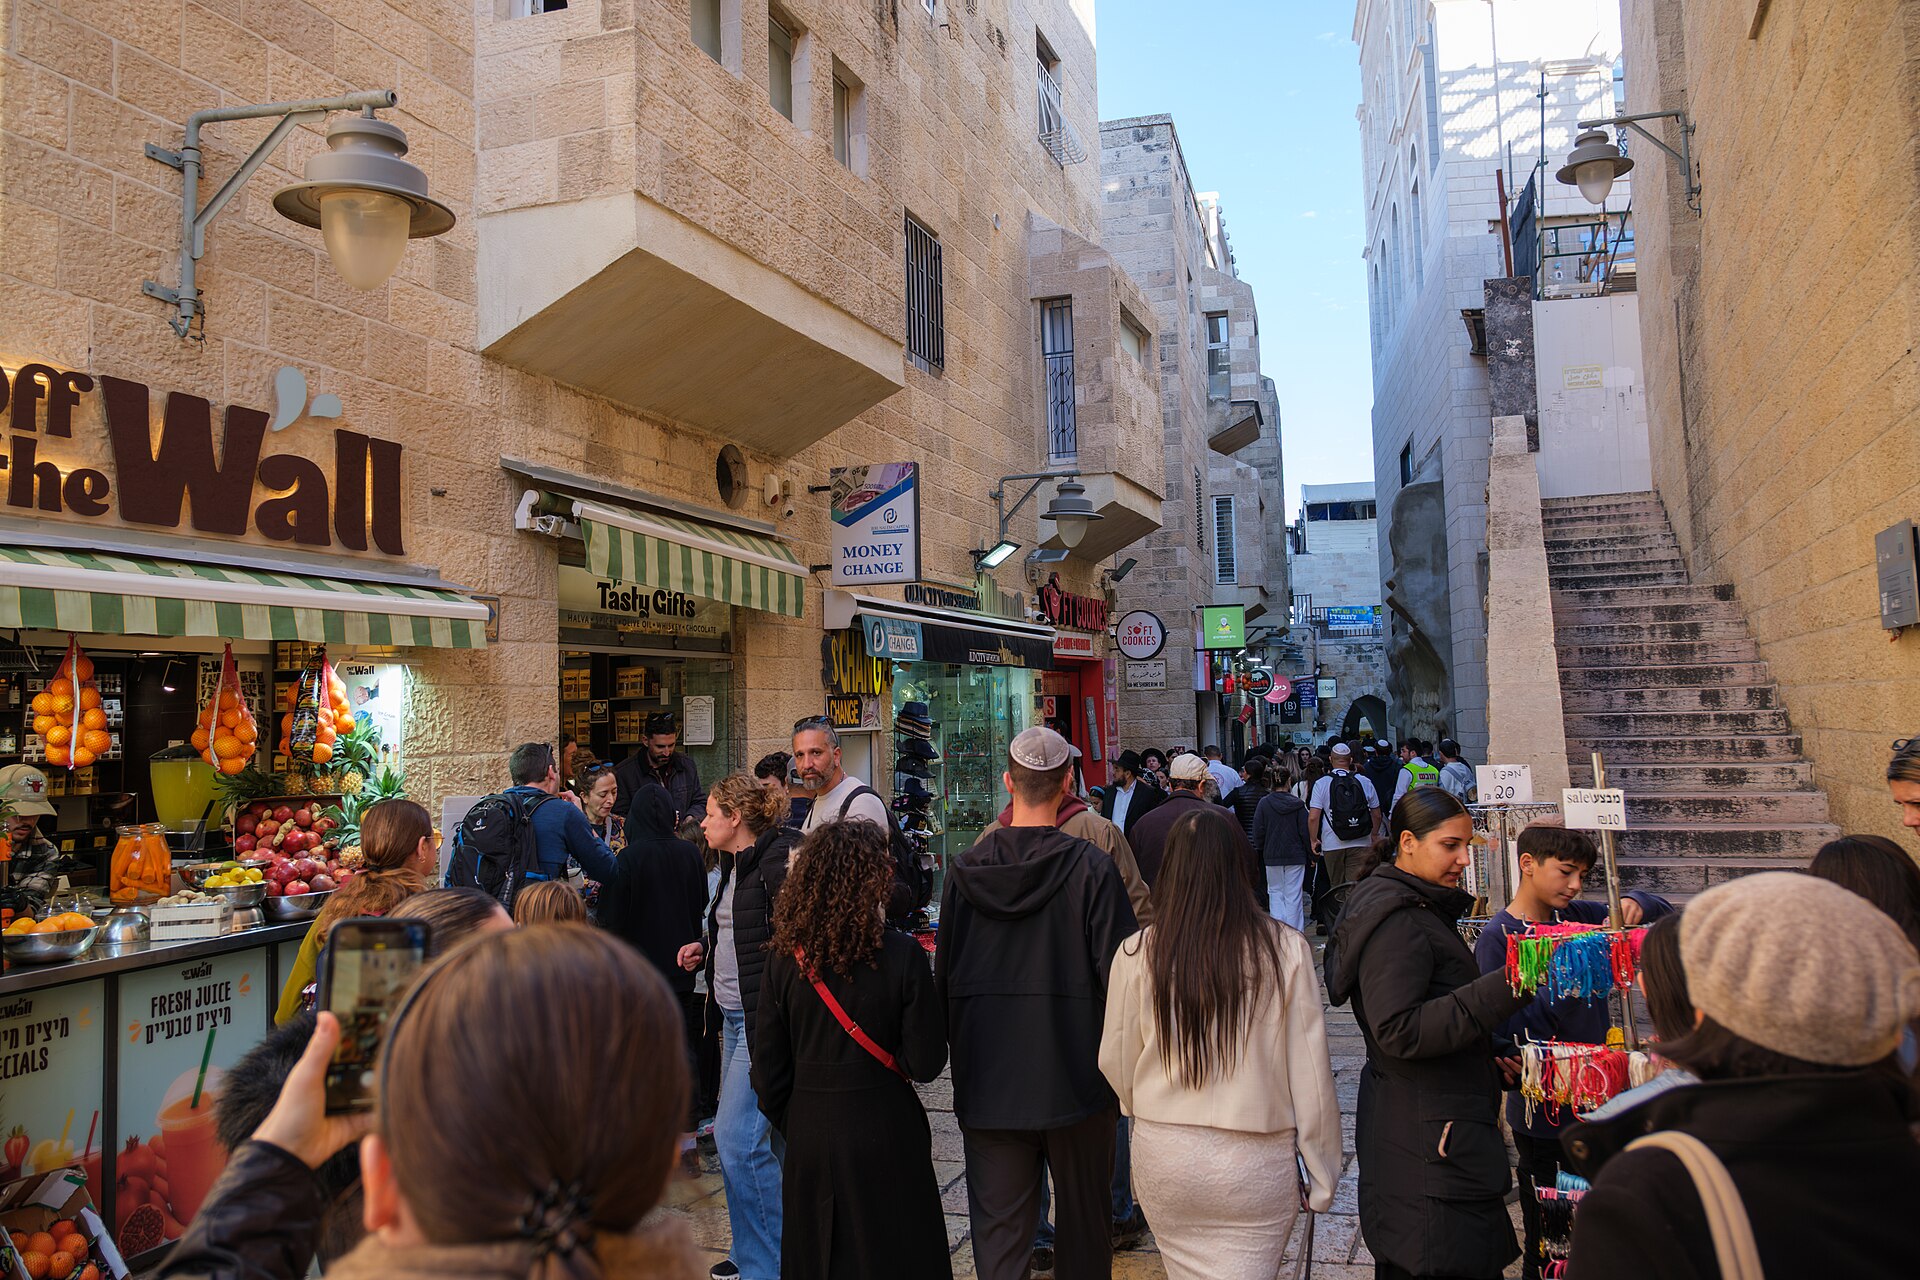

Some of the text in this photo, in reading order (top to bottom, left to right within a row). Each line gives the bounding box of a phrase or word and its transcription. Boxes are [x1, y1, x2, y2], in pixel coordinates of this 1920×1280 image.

[0, 363, 94, 438] ff
[0, 434, 109, 516] he
[100, 375, 405, 556] Wall
[842, 543, 903, 558] MONEY
[842, 562, 904, 576] CHANGE
[596, 581, 696, 618] Tasty Gifts
[567, 614, 588, 623] HALVA
[622, 619, 640, 627] OLIVE
[642, 620, 652, 628] OIL
[656, 622, 681, 631] WHISKEY
[686, 625, 717, 634] CHOCOLATE
[889, 637, 916, 650] CHANGE
[1122, 636, 1157, 646] COOKIES
[355, 665, 375, 675] Wall
[829, 699, 860, 725] CHANGE
[1493, 785, 1515, 799] 20
[190, 964, 213, 979] Wall
[3, 1001, 33, 1018] Wall
[151, 981, 231, 1018] FRESH JUICE
[25, 1017, 69, 1046] מיצים
[145, 1006, 231, 1045] מיצים טבעיים
